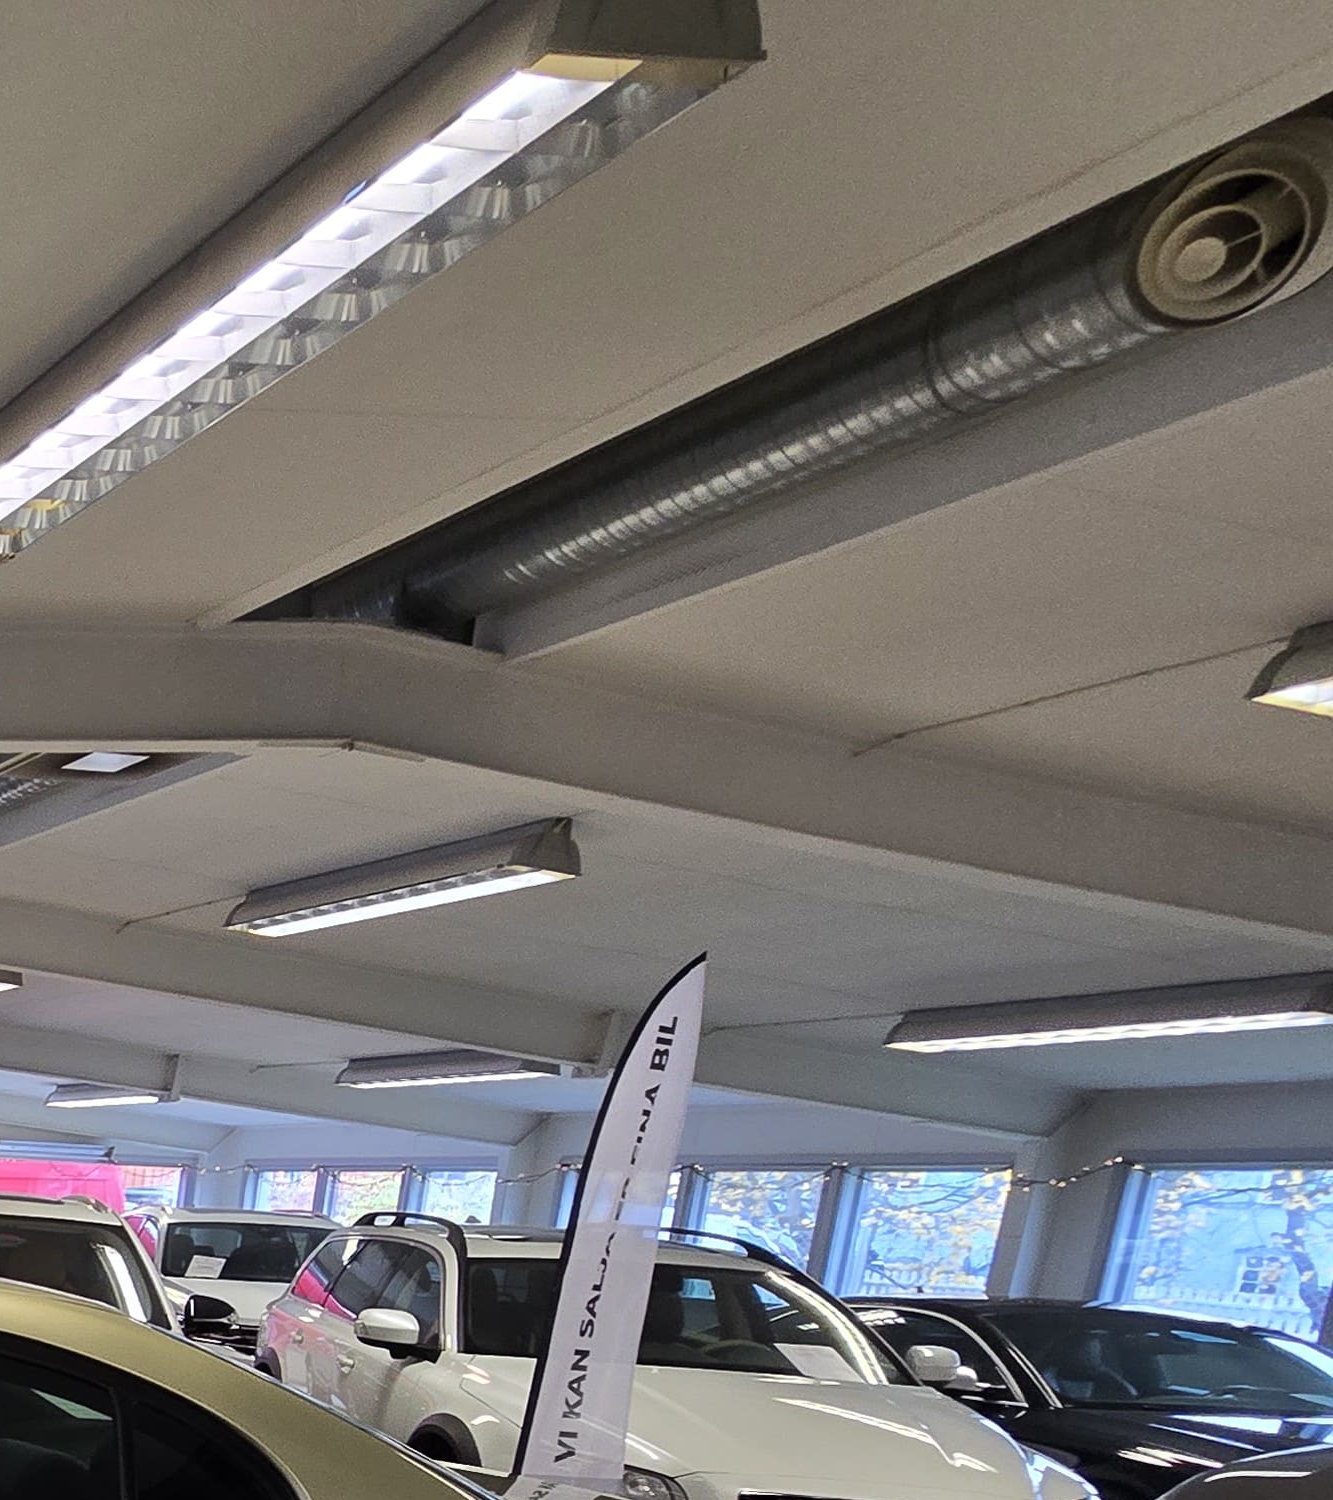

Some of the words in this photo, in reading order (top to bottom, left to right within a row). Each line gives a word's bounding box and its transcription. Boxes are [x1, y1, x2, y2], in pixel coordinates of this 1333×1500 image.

[649, 1016, 678, 1071] BIL
[562, 1348, 591, 1420] KAN
[554, 1431, 579, 1464] VI
